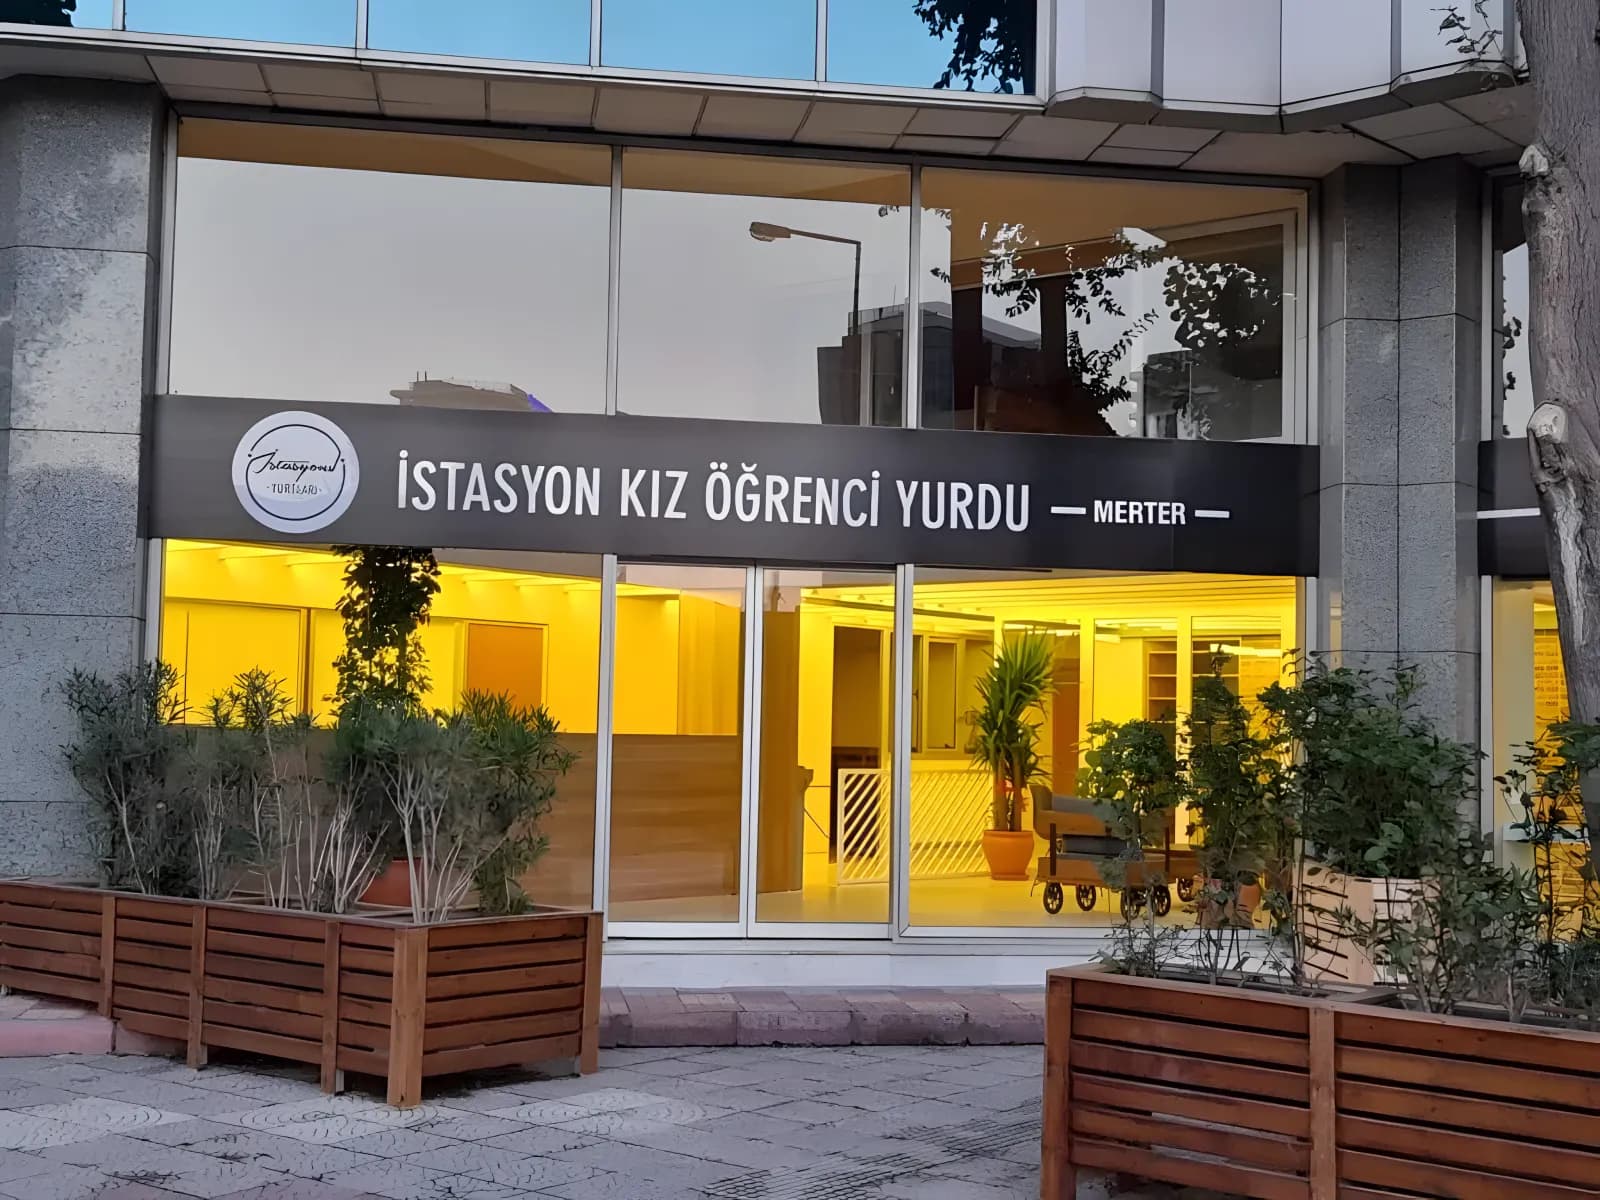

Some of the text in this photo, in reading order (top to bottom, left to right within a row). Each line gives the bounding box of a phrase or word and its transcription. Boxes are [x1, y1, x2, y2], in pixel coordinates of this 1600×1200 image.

[398, 449, 1186, 532] İSTASYON KIZ ÖĞRENCİ YURDU MERTER
